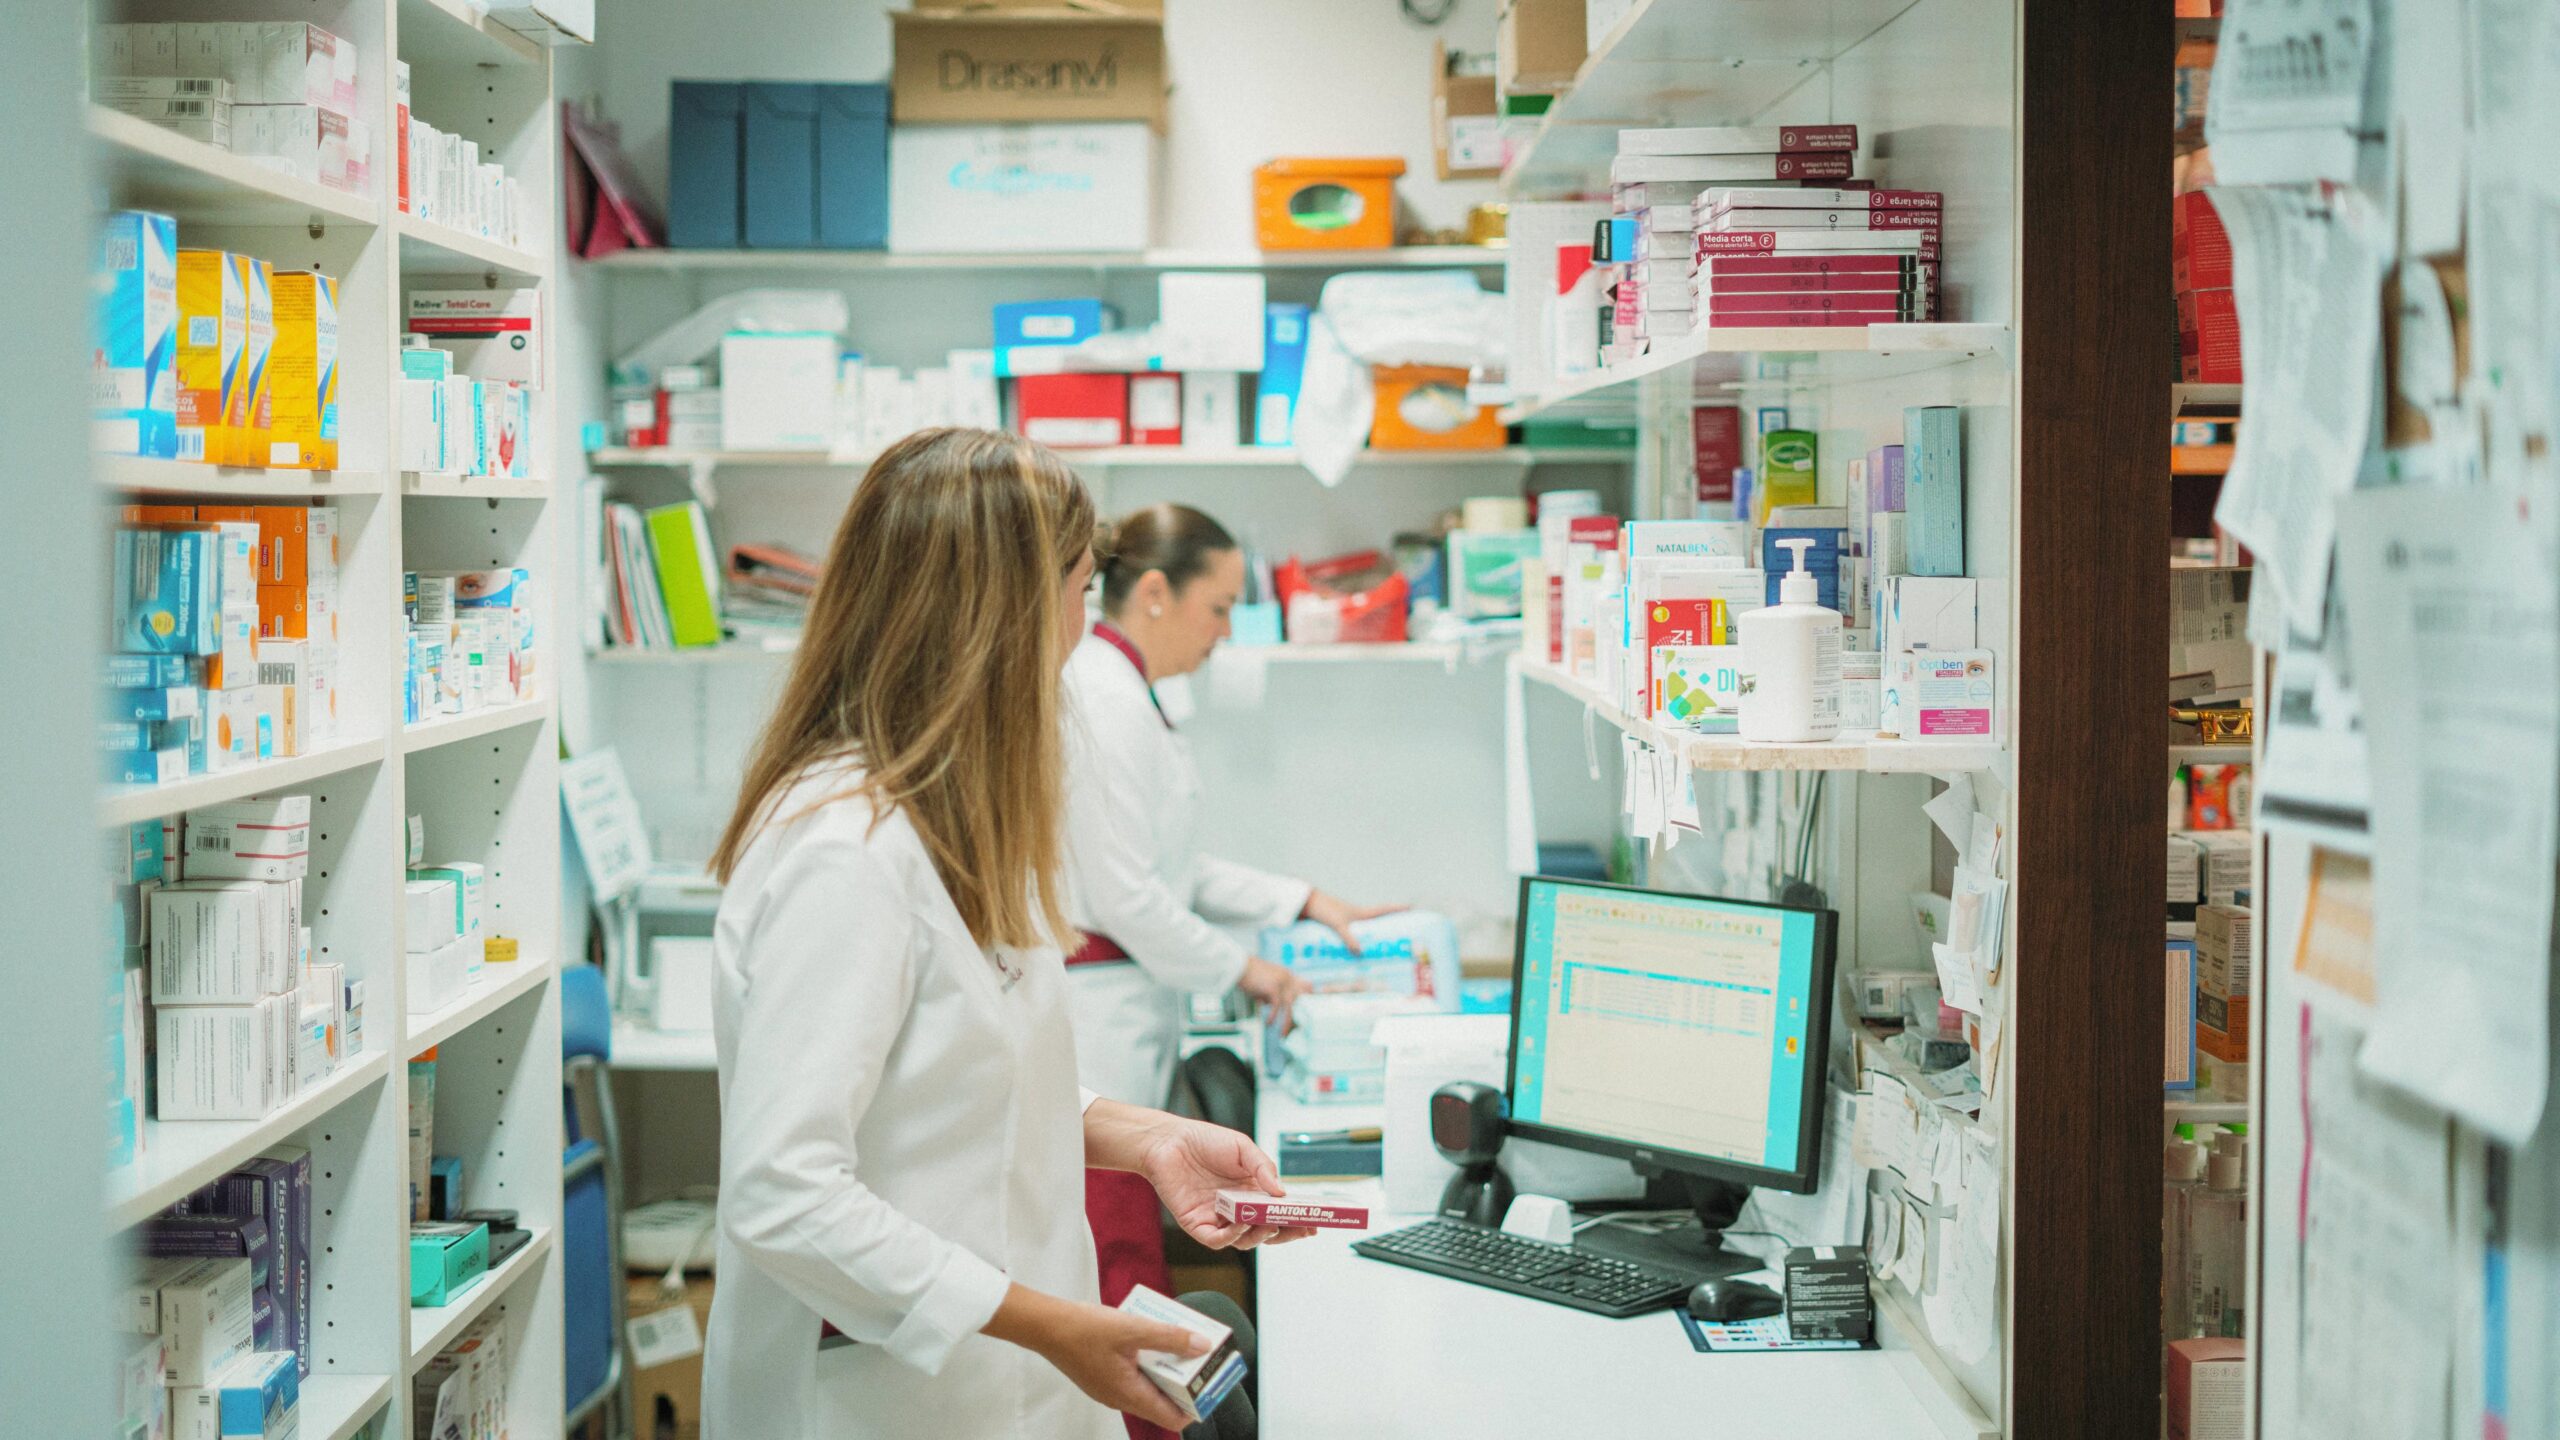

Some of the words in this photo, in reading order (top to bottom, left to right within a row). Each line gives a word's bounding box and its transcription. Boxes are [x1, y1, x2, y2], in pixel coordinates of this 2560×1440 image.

[937, 44, 1119, 91] Drasanvi
[1889, 199, 1911, 207] larga
[1913, 199, 1938, 207] Media
[1889, 218, 1911, 226] larga
[1704, 235, 1729, 243] Media
[1731, 235, 1753, 243] corta
[413, 300, 441, 308] Relive
[446, 300, 468, 309] Total
[469, 300, 491, 309] Care
[1656, 543, 1708, 553] NATALBEN
[1919, 658, 1964, 671] Optiben
[1266, 1205, 1307, 1216] PANTOK
[1308, 1208, 1321, 1217] 10
[1321, 1211, 1335, 1219] mg
[277, 1177, 287, 1295] fisiocrem
[298, 1260, 306, 1373] fisiocrem
